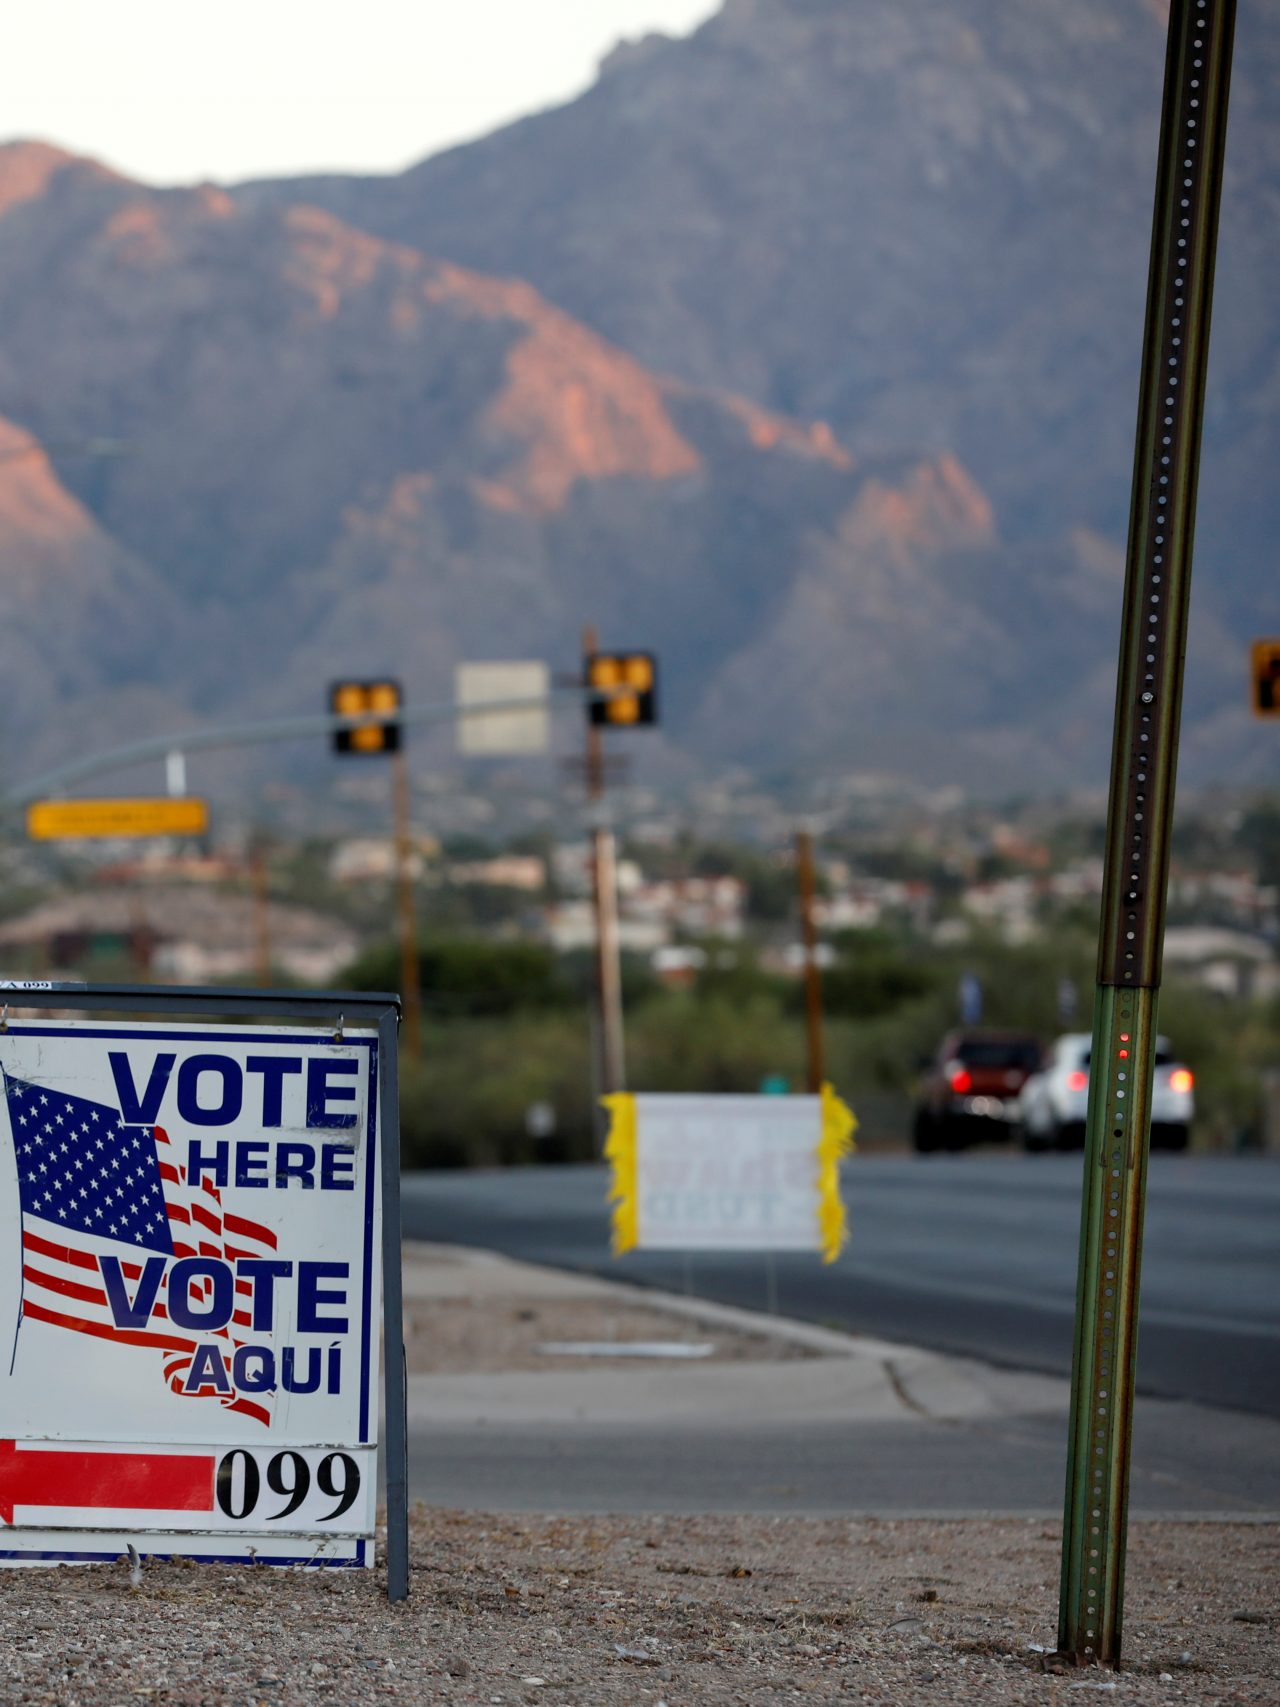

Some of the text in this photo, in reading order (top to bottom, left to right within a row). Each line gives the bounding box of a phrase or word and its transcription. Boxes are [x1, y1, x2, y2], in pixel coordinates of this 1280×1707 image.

[108, 1052, 359, 1129] VOTE
[187, 1140, 355, 1191] HERE
[99, 1256, 350, 1334] VOTE
[185, 1341, 341, 1395] AQUÍ
[216, 1449, 361, 1522] 099
